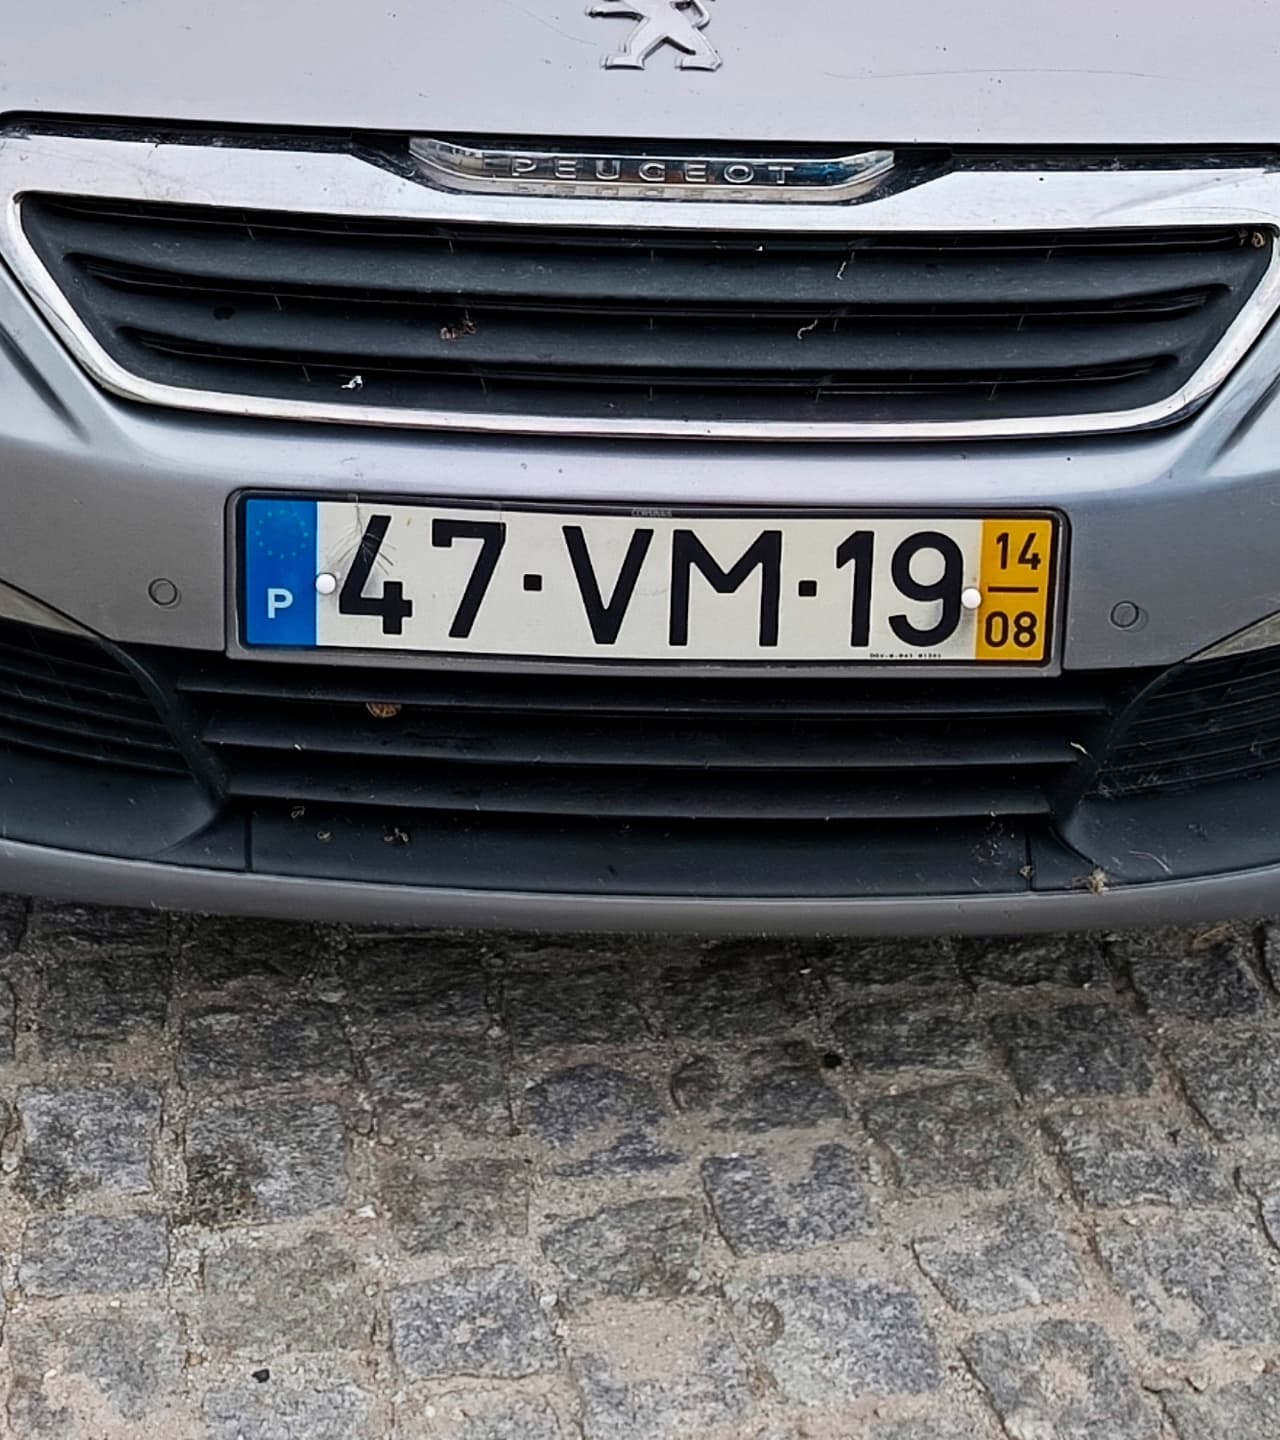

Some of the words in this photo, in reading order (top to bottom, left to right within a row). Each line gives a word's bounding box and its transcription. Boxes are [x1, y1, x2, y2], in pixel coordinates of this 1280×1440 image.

[511, 159, 795, 185] PEUGEOT
[996, 532, 1042, 571] 14
[268, 588, 293, 619] P
[984, 610, 1038, 648] 08
